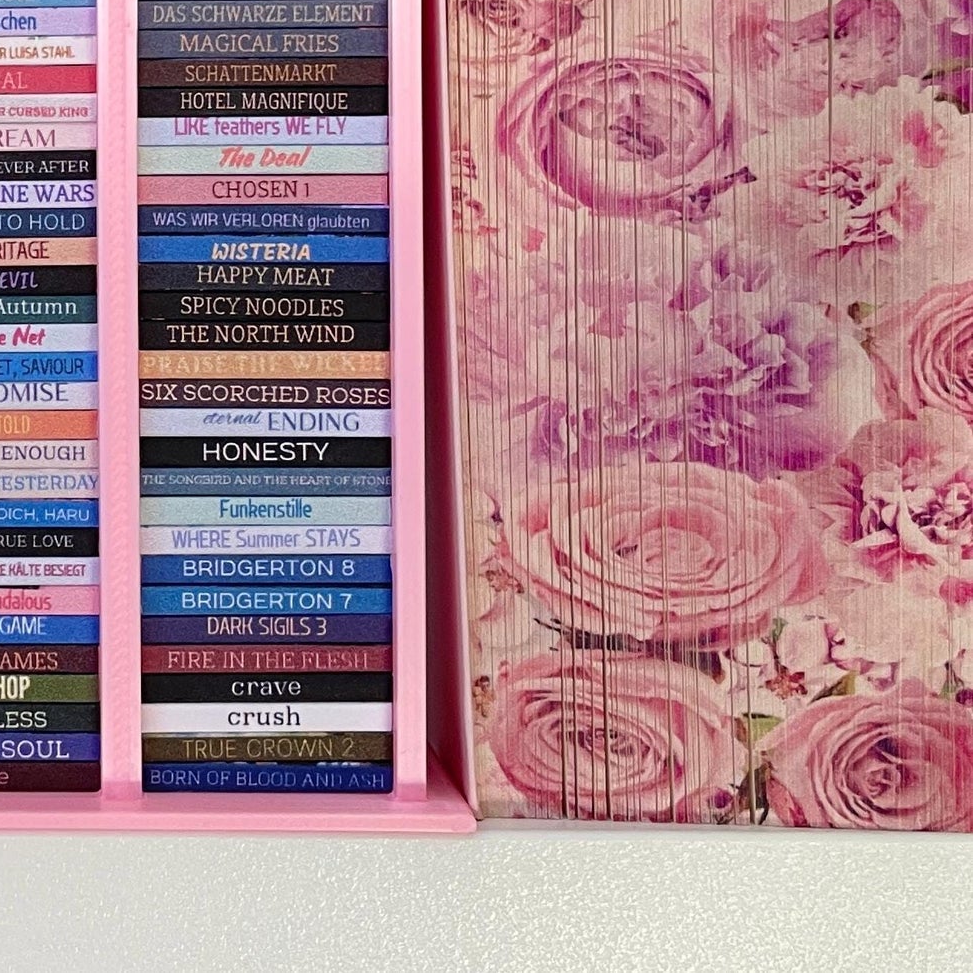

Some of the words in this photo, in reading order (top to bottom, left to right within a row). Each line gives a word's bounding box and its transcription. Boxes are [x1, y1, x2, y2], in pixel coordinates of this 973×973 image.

[153, 6, 186, 22] DAS
[192, 5, 287, 22] SCHWARZE
[292, 5, 374, 22] ELEMENT
[180, 34, 278, 52] MAGICAL
[282, 34, 339, 52] FRIES
[185, 65, 338, 82] SCHATTENMARKT
[180, 92, 236, 110] HOTEL
[242, 92, 348, 114] MAGNIFIQUE
[175, 118, 209, 135] LIKE
[285, 117, 311, 135] WE
[316, 116, 346, 135] FLY
[219, 147, 256, 168] The
[259, 146, 312, 168] Deal
[39, 161, 89, 173] AFTER
[34, 184, 94, 202] WARS
[212, 181, 297, 198] CHOSEN
[29, 213, 85, 230] HOLD
[153, 212, 186, 226] WAS
[191, 212, 218, 226] WIR
[222, 213, 303, 228] VERLOREN
[308, 213, 370, 231] glaubten
[211, 242, 311, 261] WISTERIA
[0, 272, 38, 289] EVIL
[197, 265, 268, 284] HAPPY
[273, 267, 334, 286] MEAT
[180, 296, 242, 315] SPICY
[245, 297, 344, 317] NOODLES
[13, 326, 46, 346] Net
[167, 325, 209, 343] THE
[214, 325, 289, 343] NORTH
[291, 325, 355, 343] WIND
[22, 358, 84, 375] SAVIOUR
[141, 384, 178, 401] SIX
[183, 384, 309, 403] SCORCHED
[316, 388, 390, 405] ROSES
[203, 411, 262, 425] eternal
[268, 412, 359, 431] ENDING
[2, 446, 85, 460] ENOUGH
[203, 442, 329, 461] HONESTY
[219, 499, 313, 519] Funkenstille
[32, 535, 73, 547] LOVE
[172, 530, 231, 549] WHERE
[236, 530, 300, 548] Summer
[306, 529, 361, 547] STAYS
[183, 560, 333, 576] BRIDGERTON
[342, 560, 355, 575] 8
[181, 593, 332, 609] BRIDGERTON
[340, 593, 352, 609] 7
[0, 618, 47, 634] GAME
[208, 617, 253, 635] DARK
[259, 617, 311, 636] SIGILS
[317, 617, 327, 635] 3
[232, 681, 302, 696] crave
[228, 706, 300, 726] crush
[2, 740, 69, 758] SOUL
[184, 739, 238, 758] TRUE
[247, 739, 332, 757] CROWN
[342, 738, 354, 757] 2
